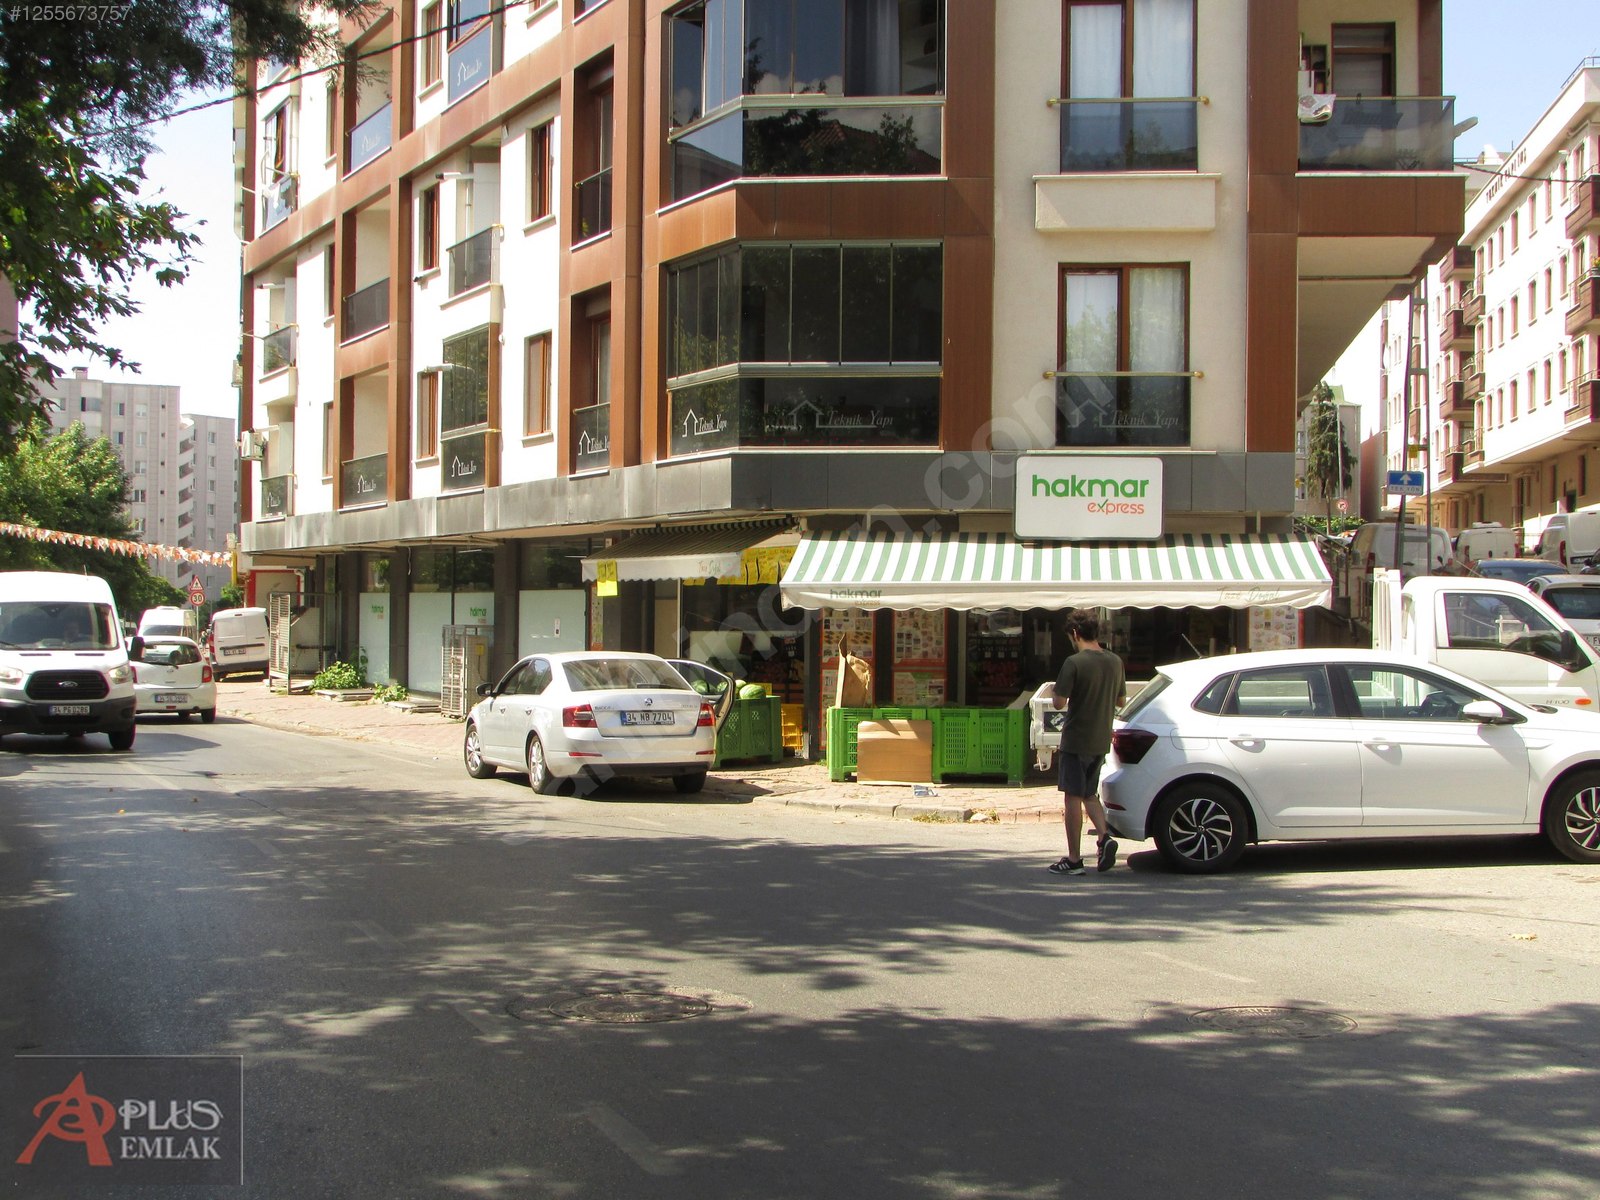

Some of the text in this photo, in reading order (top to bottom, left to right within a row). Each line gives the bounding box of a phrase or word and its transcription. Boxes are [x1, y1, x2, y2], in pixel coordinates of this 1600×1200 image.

[828, 410, 862, 425] Teknik
[1111, 409, 1146, 426] Teknik
[1031, 474, 1150, 498] hakmar
[1087, 499, 1145, 515] express
[193, 594, 203, 603] 30
[830, 588, 882, 599] hakmar
[626, 712, 672, 722] 34 NB 7704
